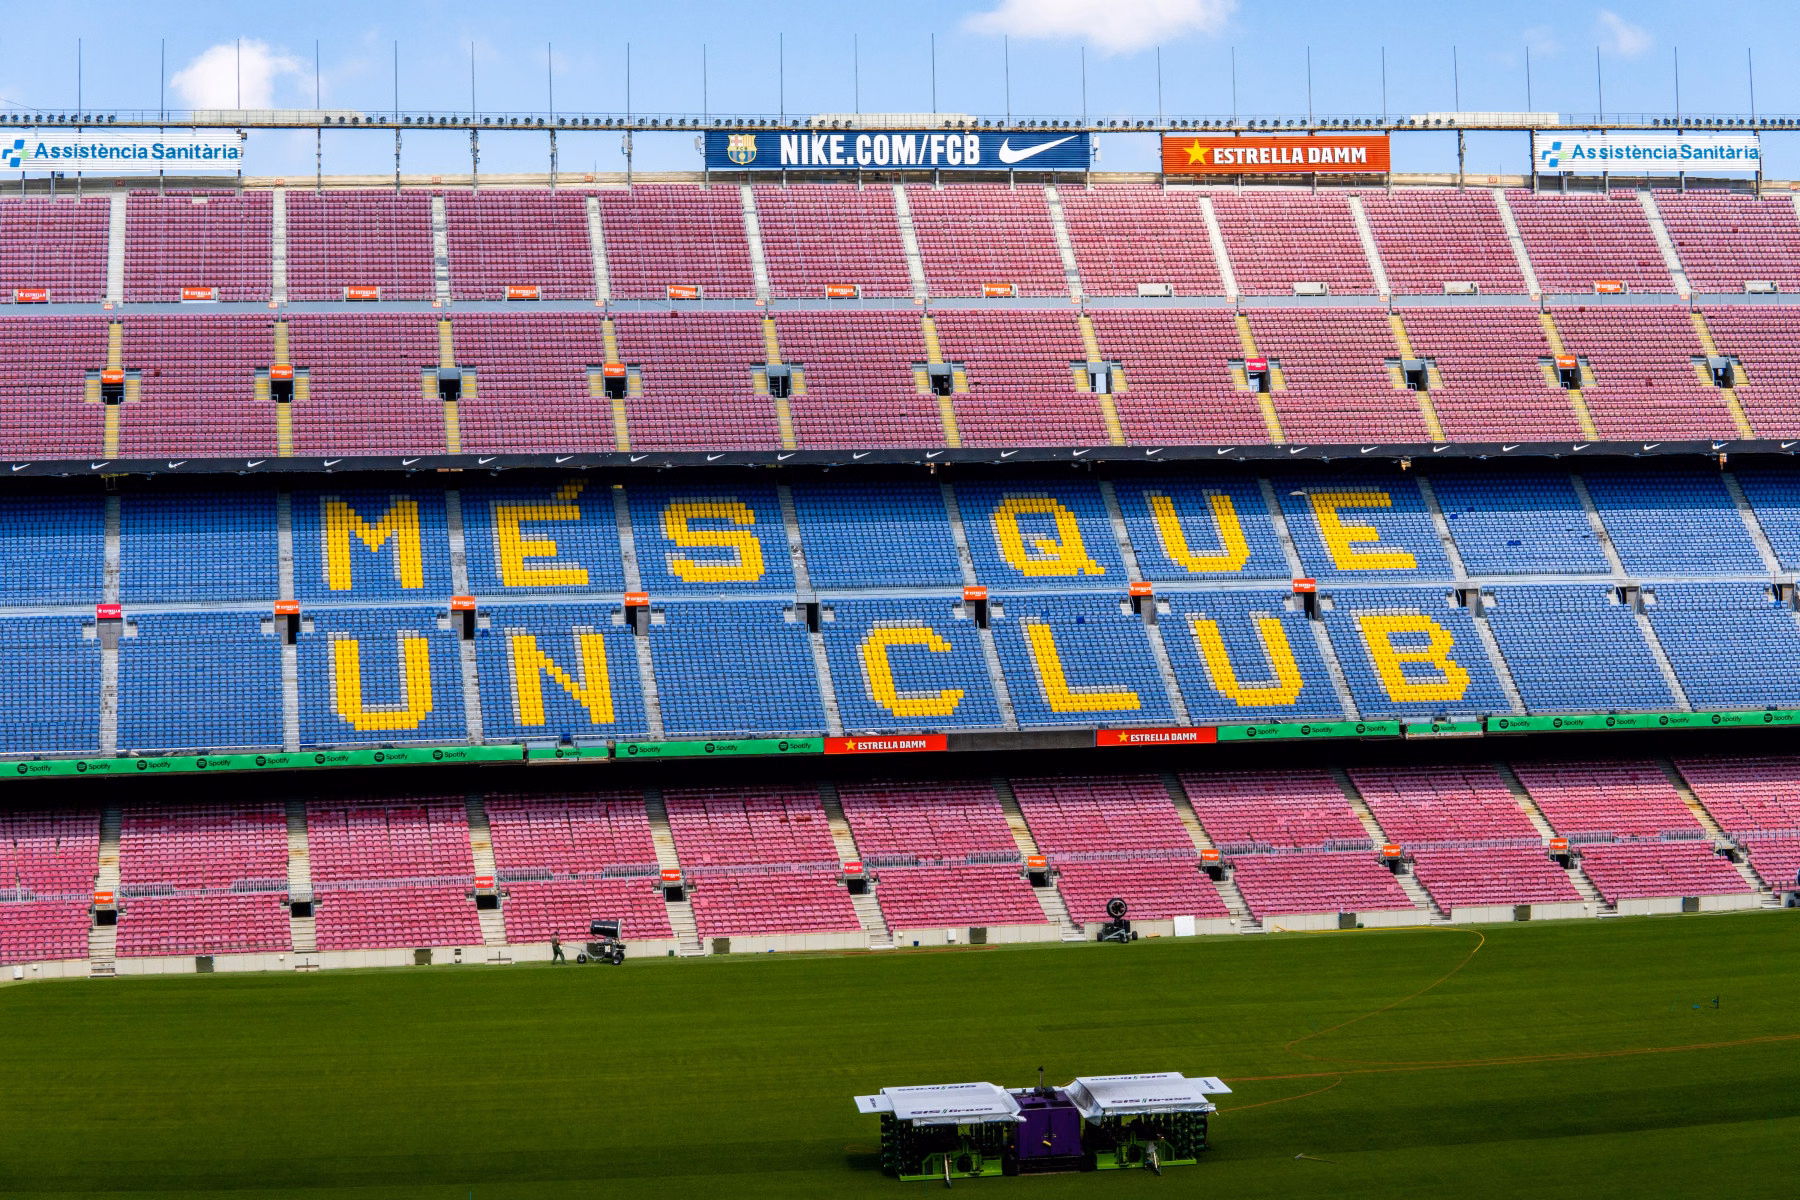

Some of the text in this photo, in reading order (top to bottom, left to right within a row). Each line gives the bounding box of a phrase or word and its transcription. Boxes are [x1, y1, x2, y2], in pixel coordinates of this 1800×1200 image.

[35, 143, 238, 159] Assistència Sanitària
[780, 134, 980, 165] NIKE.COM/FCB
[1572, 144, 1758, 159] Assistència Sanitària
[1213, 147, 1366, 164] ESTRELLA DAMM
[322, 479, 1417, 591] MÉS QUE
[331, 611, 1471, 731] UN CLUB
[1616, 718, 1637, 726] Spotify
[1670, 717, 1690, 726] Spotify
[1722, 715, 1742, 724] Spotify
[1773, 714, 1794, 723] Spotify
[1510, 720, 1531, 729] Spotify
[1563, 719, 1584, 728] Spotify
[1257, 728, 1279, 737] Spotify
[1311, 726, 1332, 736] Spotify
[1366, 725, 1388, 734] Spotify
[1130, 732, 1196, 742] ESTRELLA DAMM
[716, 744, 738, 753] Spotify
[790, 743, 812, 752] Spotify
[858, 740, 926, 750] ESTRELLA DAMM
[639, 746, 662, 754] Spotify
[326, 755, 349, 764] Spotify
[386, 753, 408, 762] Spotify
[444, 751, 467, 760] Spotify
[148, 761, 171, 770] Spotify
[208, 759, 231, 768] Spotify
[268, 757, 290, 766] Spotify
[29, 764, 52, 773] Spotify
[88, 762, 111, 772] Spotify
